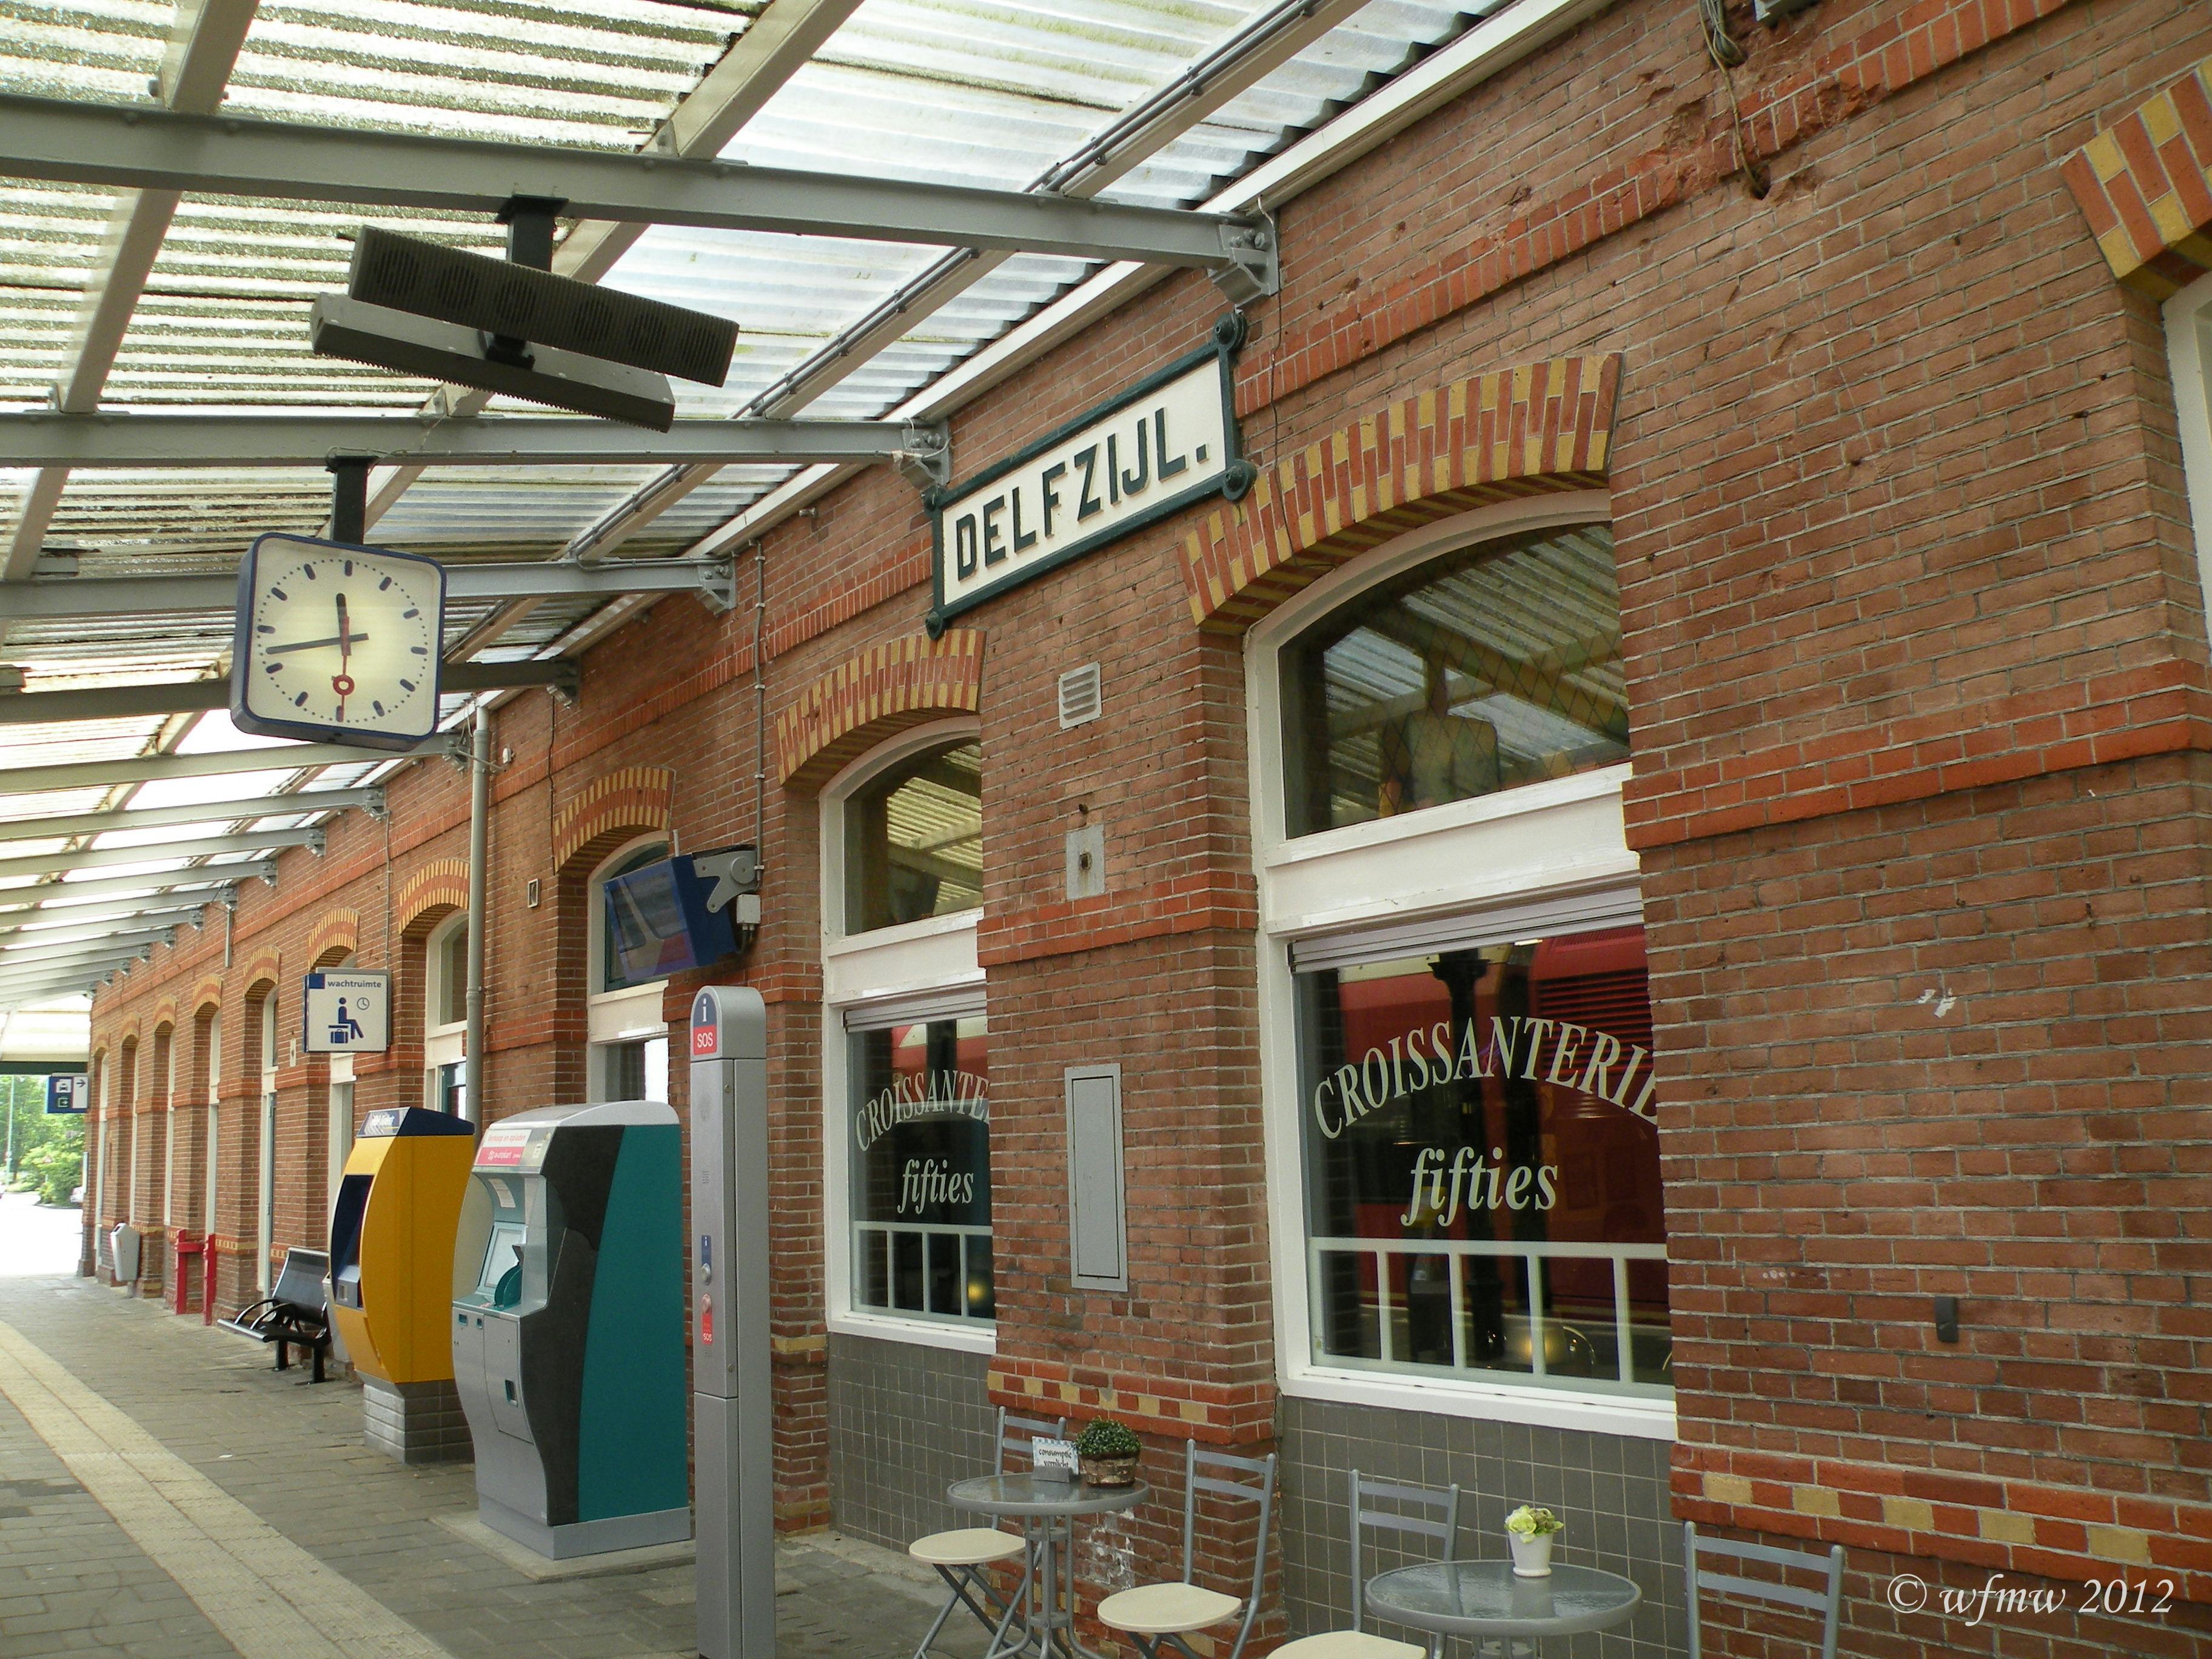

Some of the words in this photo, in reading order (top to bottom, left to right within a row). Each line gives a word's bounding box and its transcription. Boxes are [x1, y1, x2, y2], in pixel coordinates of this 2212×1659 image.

[327, 979, 382, 988] wachtruimte
[697, 1031, 714, 1048] SOS
[856, 1069, 990, 1151] CROISSANTE
[897, 1158, 974, 1215] fifties
[1400, 1146, 1558, 1227] fifties
[703, 1333, 712, 1342] SOS
